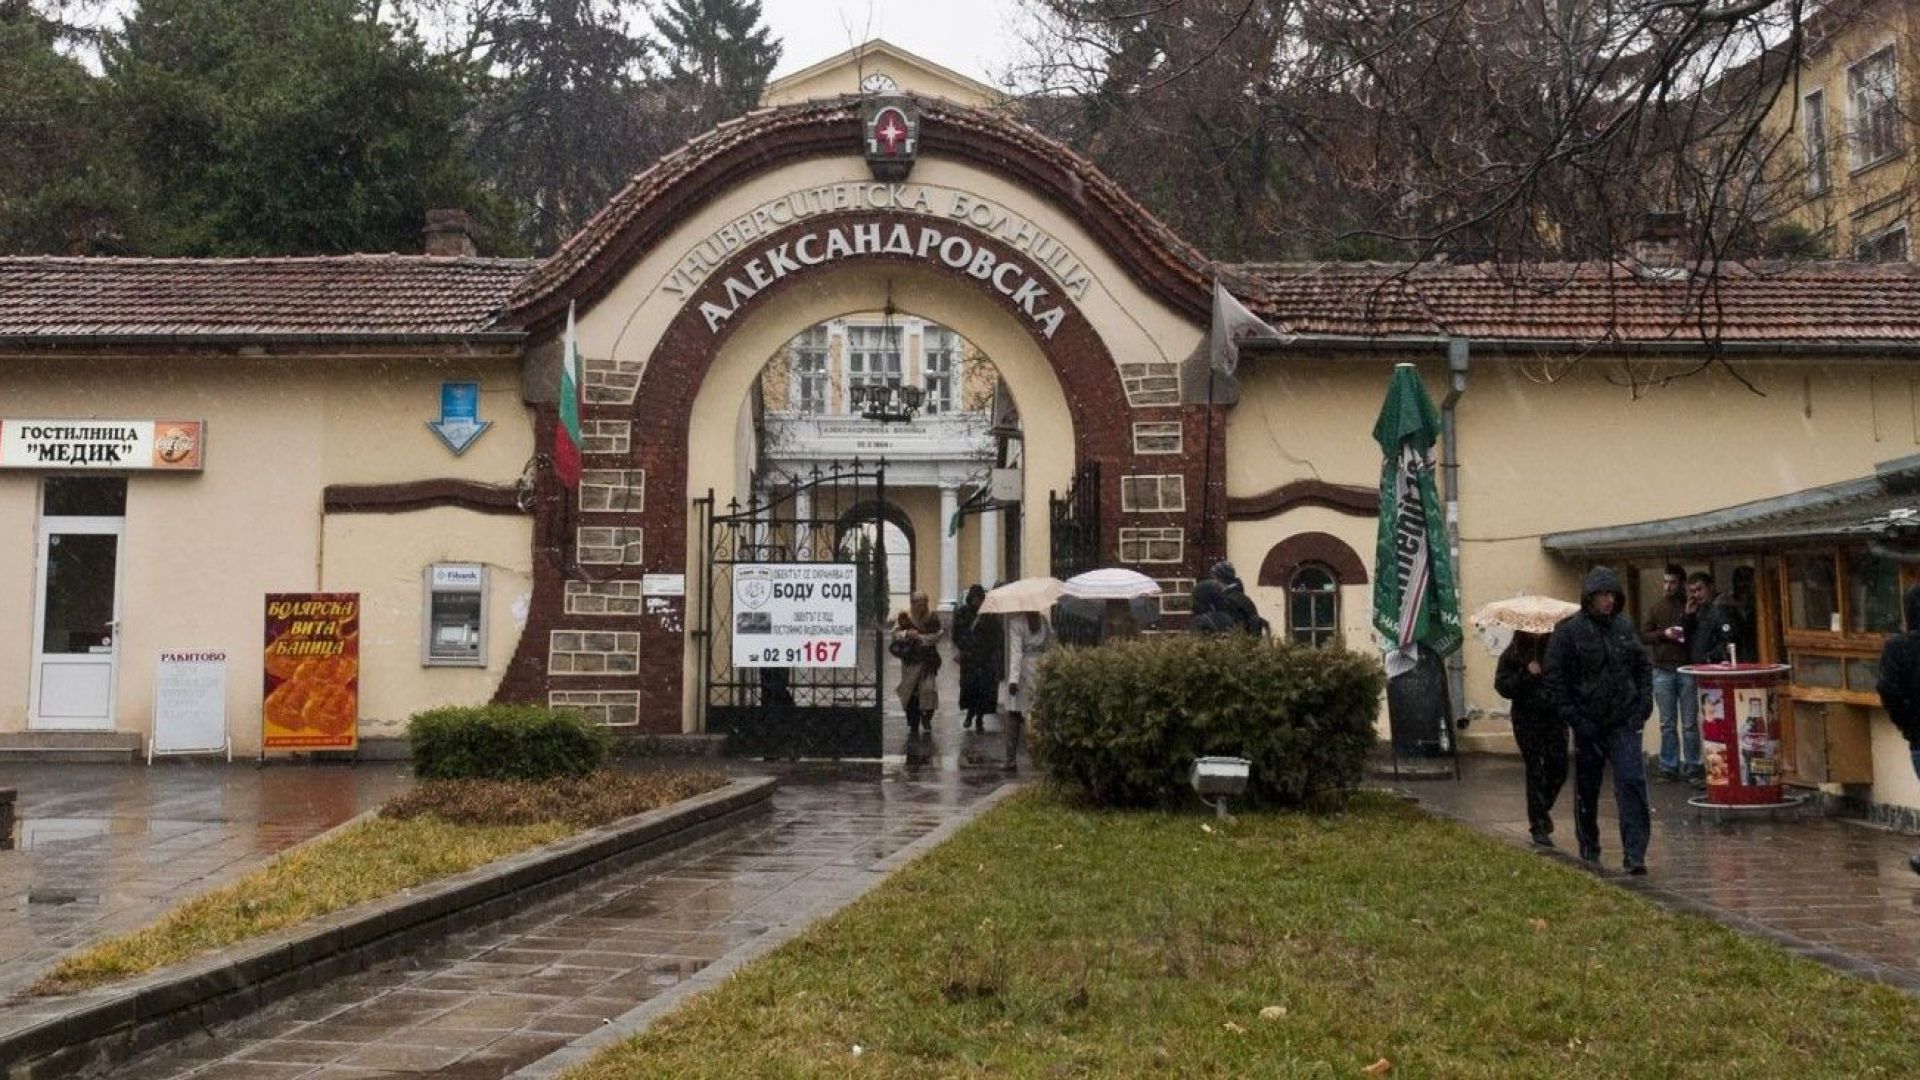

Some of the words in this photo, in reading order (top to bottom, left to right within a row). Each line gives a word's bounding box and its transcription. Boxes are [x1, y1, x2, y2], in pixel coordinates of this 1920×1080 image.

[698, 222, 1066, 338] АЛЕКСАНДРОВСКА
[20, 426, 138, 441] ГОСТИЛНИЦА
[773, 583, 814, 602] БОДУ
[821, 583, 853, 602] СОД
[268, 601, 354, 618] БОЛЯРСКА
[291, 620, 336, 635] ВИТА
[276, 641, 345, 657] БАНИЦА
[763, 648, 780, 662] 02
[161, 653, 227, 662] РАКИТОВО
